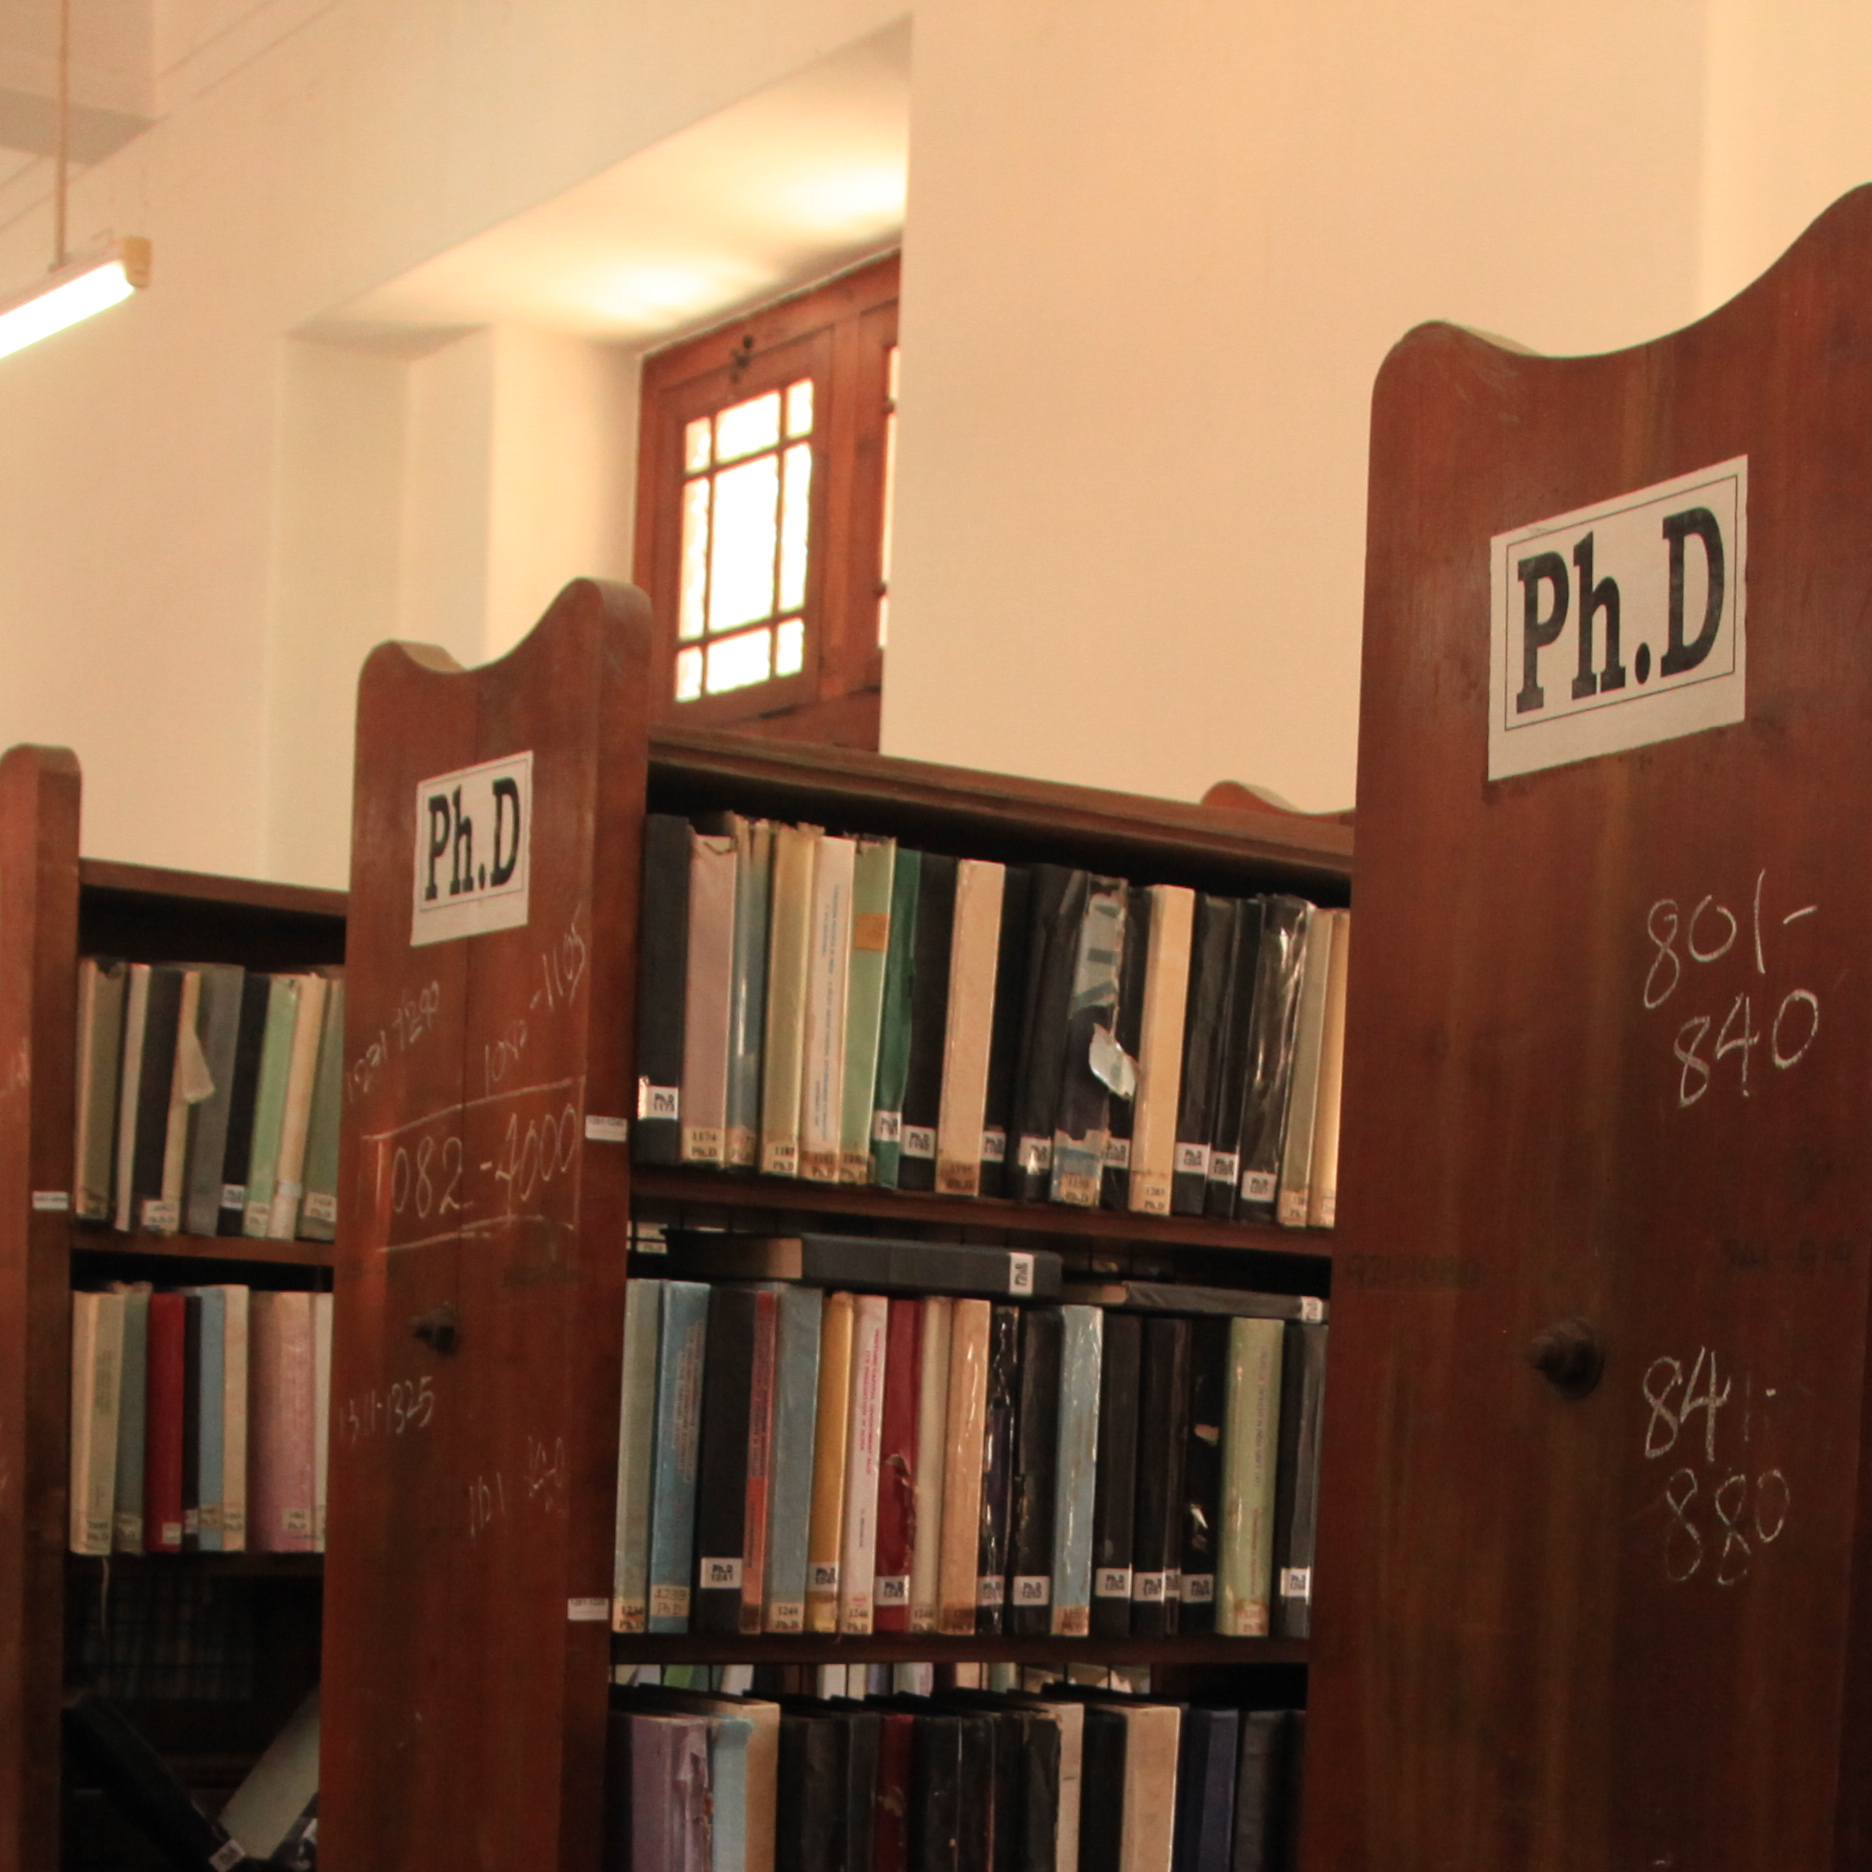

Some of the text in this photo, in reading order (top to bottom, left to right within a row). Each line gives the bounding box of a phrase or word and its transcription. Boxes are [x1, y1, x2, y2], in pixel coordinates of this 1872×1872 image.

[1515, 505, 1726, 714] Ph.D
[423, 775, 520, 901] Ph.D
[1677, 988, 1820, 1110] 840
